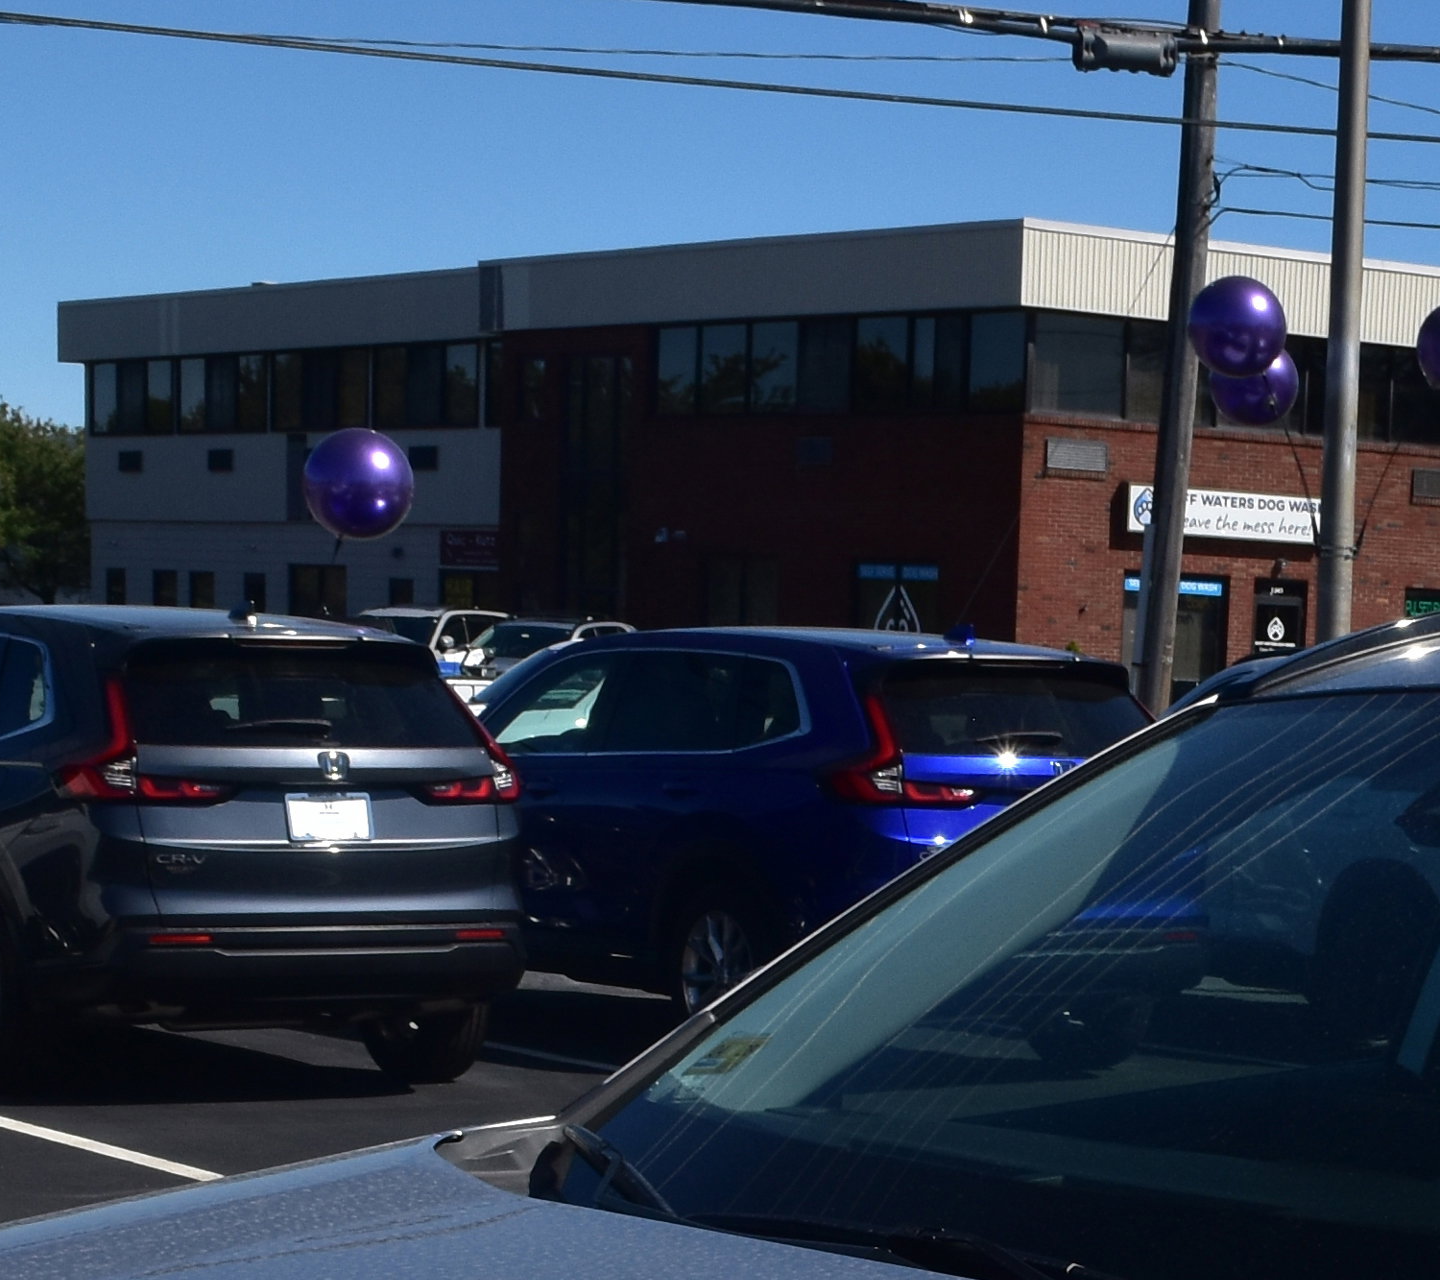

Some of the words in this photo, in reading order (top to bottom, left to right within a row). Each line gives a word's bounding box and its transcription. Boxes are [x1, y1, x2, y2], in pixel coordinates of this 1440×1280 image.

[1201, 495, 1254, 509] WATERS
[1257, 498, 1285, 511] DOG
[1184, 517, 1211, 530] eave
[1216, 514, 1238, 531] the
[1243, 521, 1274, 534] mess
[1279, 518, 1311, 536] here!
[156, 853, 207, 865] CR-V
